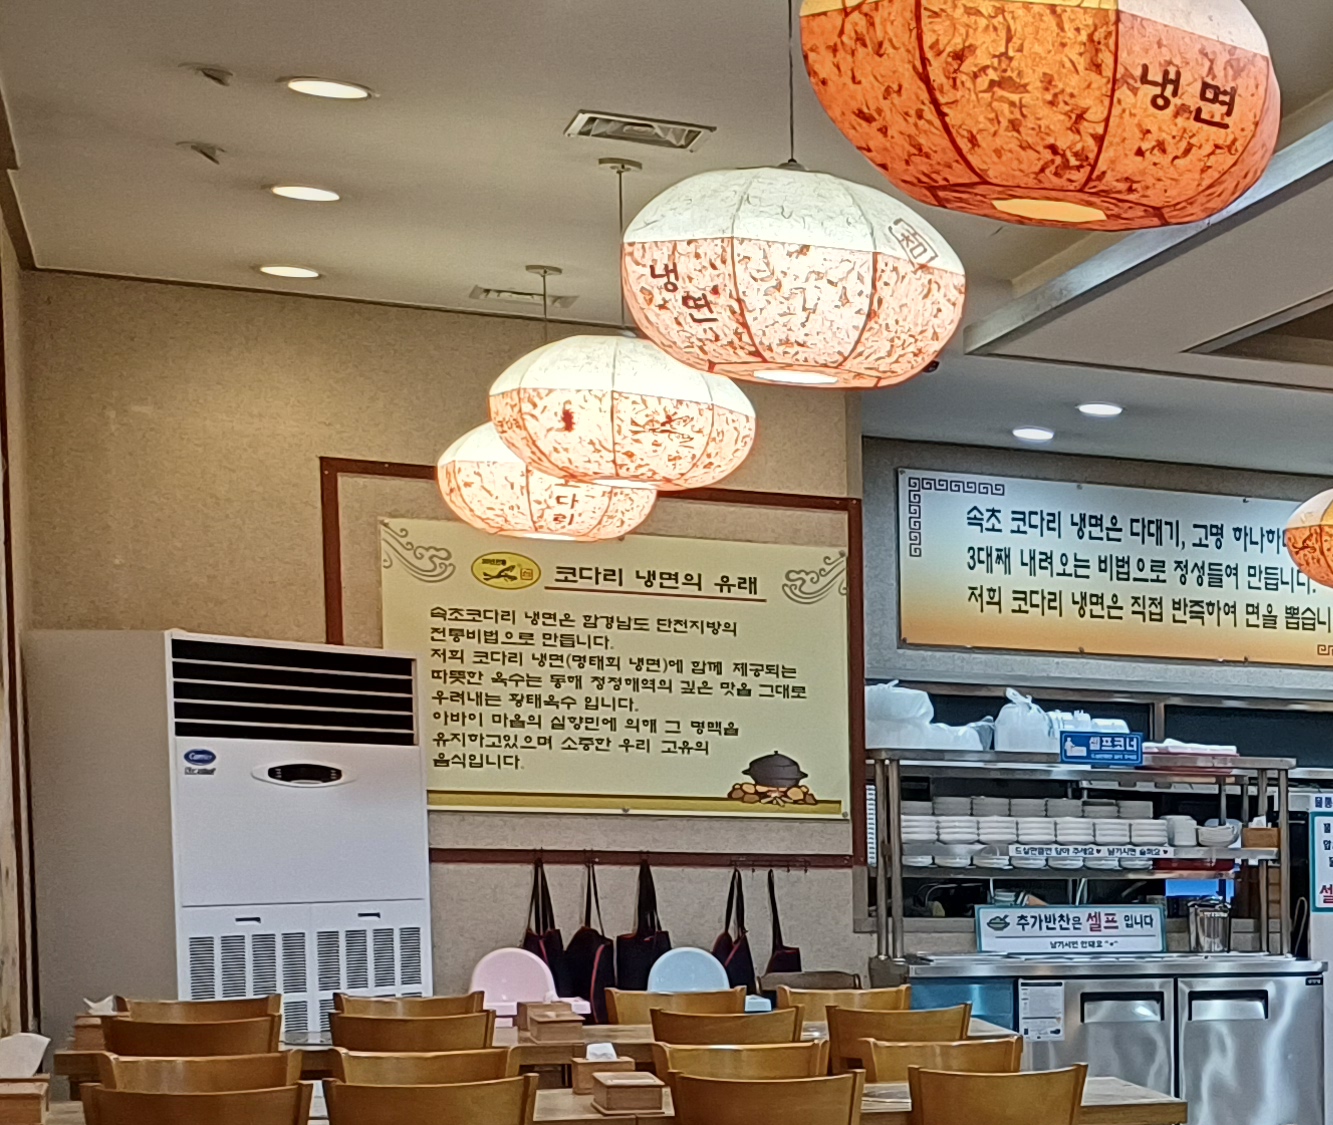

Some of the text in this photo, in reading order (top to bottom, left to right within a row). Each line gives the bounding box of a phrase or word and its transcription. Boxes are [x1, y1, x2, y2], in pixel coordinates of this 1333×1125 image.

[1140, 63, 1237, 130] 냉면
[649, 262, 719, 324] 냉면
[966, 505, 1288, 555] 속초 코다리 냉면은 다대기, 고명 하나하
[554, 565, 625, 587] 코다리
[635, 568, 703, 592] 냉면의
[714, 574, 759, 595] 유래
[966, 546, 1012, 575] 3대째
[1020, 548, 1091, 579] 내려오는
[1097, 553, 1167, 584] 비법으로
[1173, 559, 1239, 590] 정성들여
[524, 610, 576, 627] 냉면은
[582, 614, 650, 631] 함경남도
[967, 585, 1003, 615] 저희
[1011, 588, 1063, 618] 코다리
[1071, 591, 1124, 621] 냉면은
[1130, 595, 1164, 623] 직접
[1171, 597, 1238, 628] 반죽하여
[1245, 602, 1278, 630] 면을
[430, 627, 615, 650] 전통비법으로 만듭니다.
[430, 648, 798, 679] 저희 코다리 냉면(명태회 냉면)에 함께 제공되는
[431, 669, 485, 686] 따뜻한
[491, 671, 543, 688] 육수는
[550, 673, 583, 690] 동해
[680, 680, 714, 696] 깊은
[720, 682, 752, 697] 맛을
[758, 684, 808, 699] 그대로
[431, 690, 639, 712] 우려내는 황태육수 입니다.
[433, 711, 739, 737] 아바이 마을의 실향민에 의해 그 명맥을
[433, 732, 710, 756] 유지하고있으며 소중한 우리 고유의
[1089, 736, 1137, 751] 셀프코너
[433, 752, 525, 770] 음식입니다.
[1016, 911, 1154, 932] 추가반찬은 셀프 입니다
